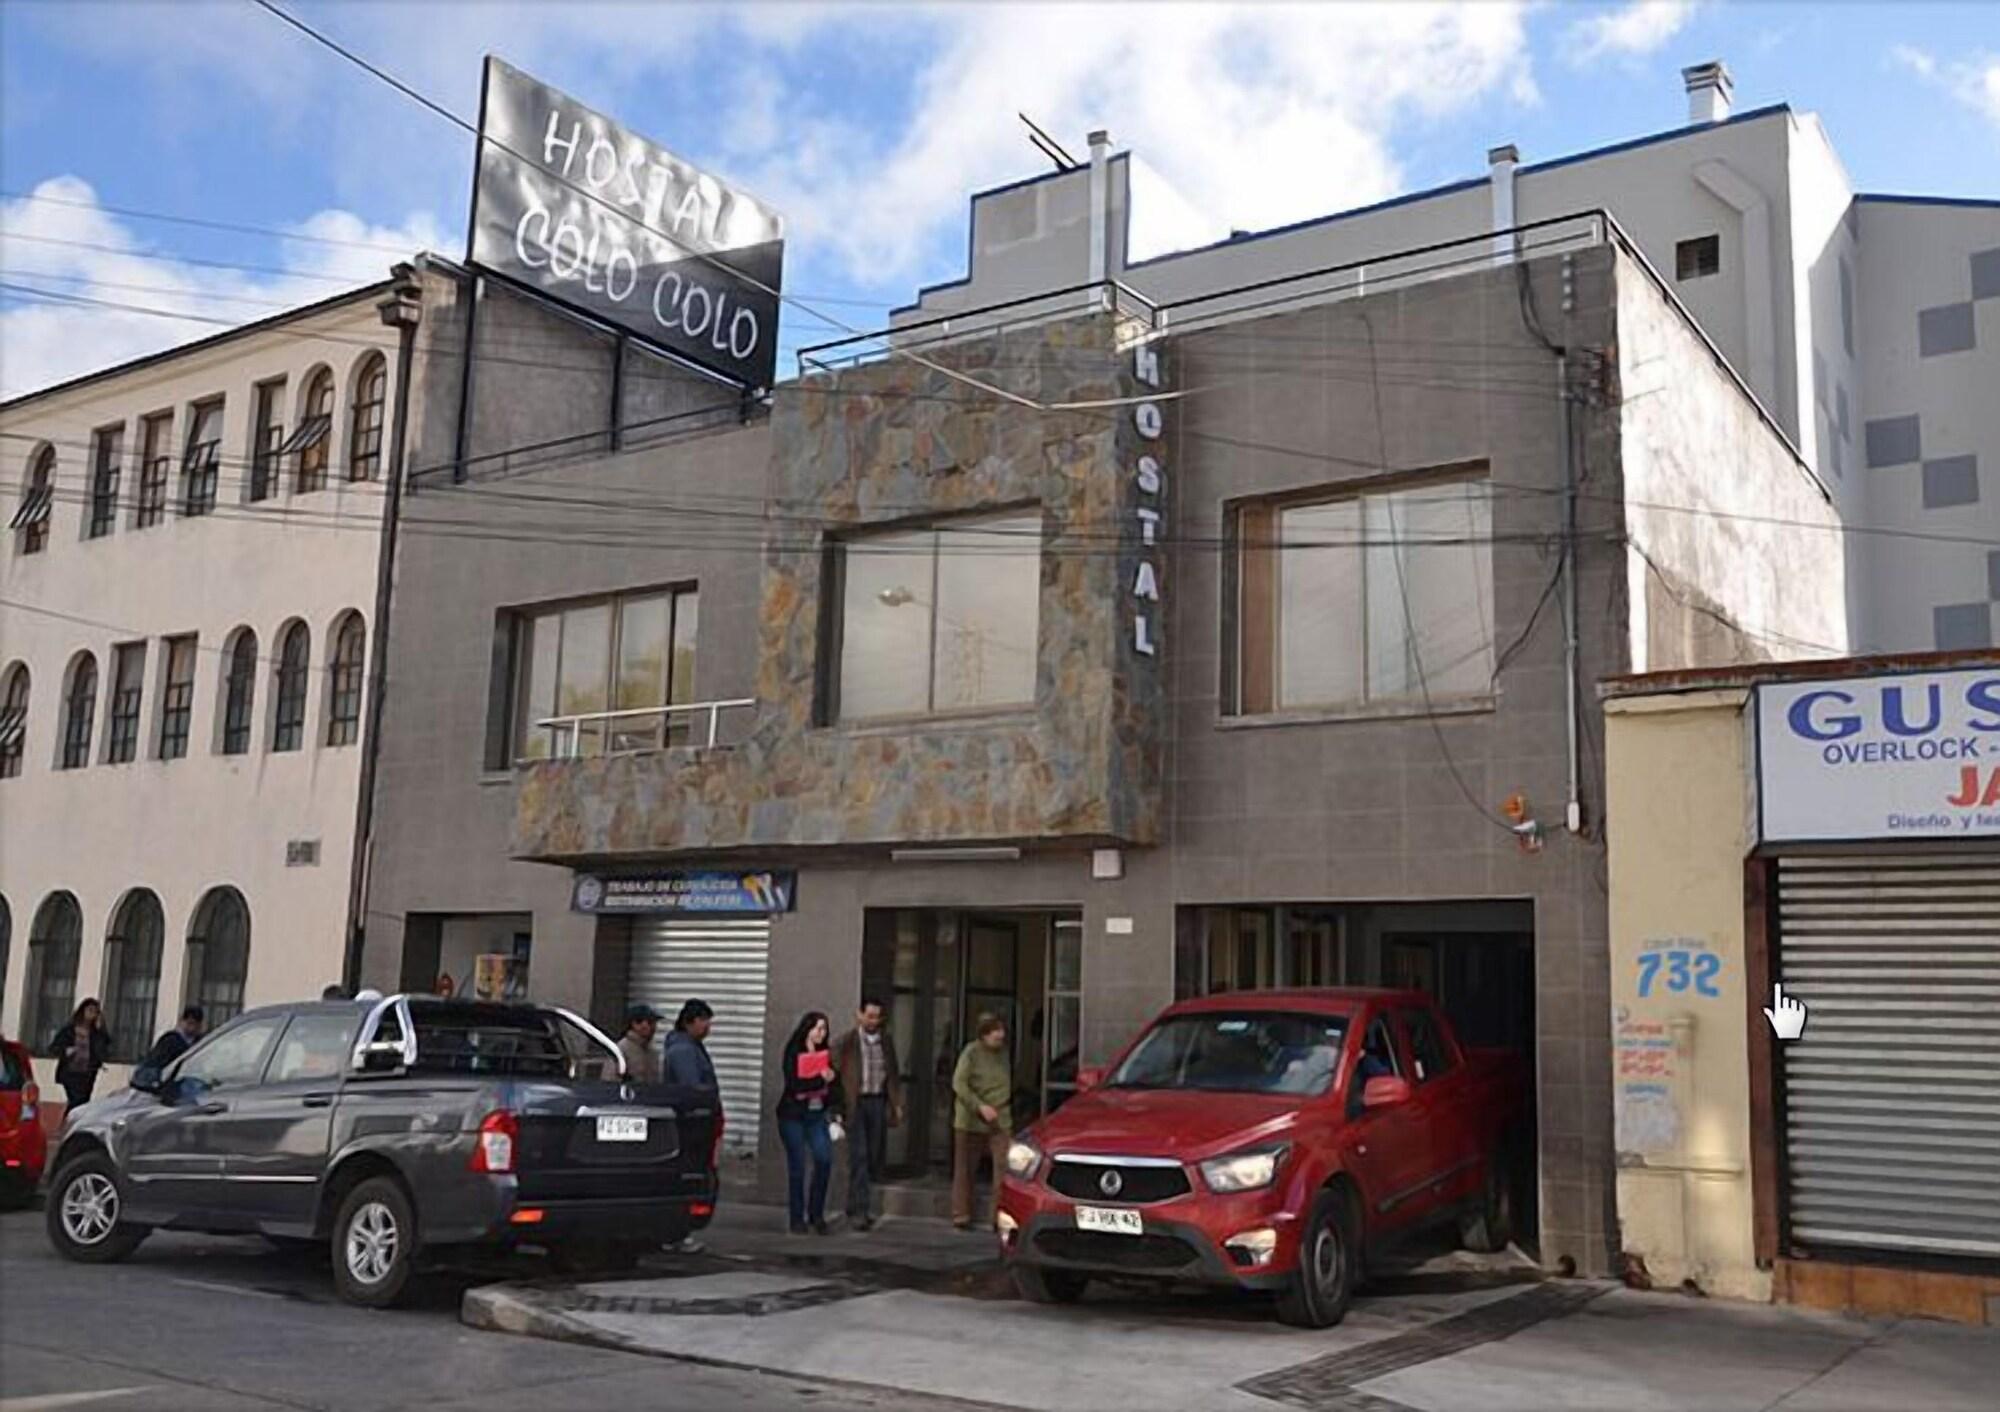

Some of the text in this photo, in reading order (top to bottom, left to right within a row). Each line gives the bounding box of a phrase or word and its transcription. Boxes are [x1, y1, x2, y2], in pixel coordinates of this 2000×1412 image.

[543, 109, 728, 250] HOSTAL
[515, 205, 758, 359] COLO COLO
[1134, 345, 1162, 656] HOSTAL
[1787, 678, 2000, 742] GUS
[1823, 736, 1980, 766] OVERLOCK
[1960, 815, 1972, 831] y
[1637, 950, 1721, 998] 732
